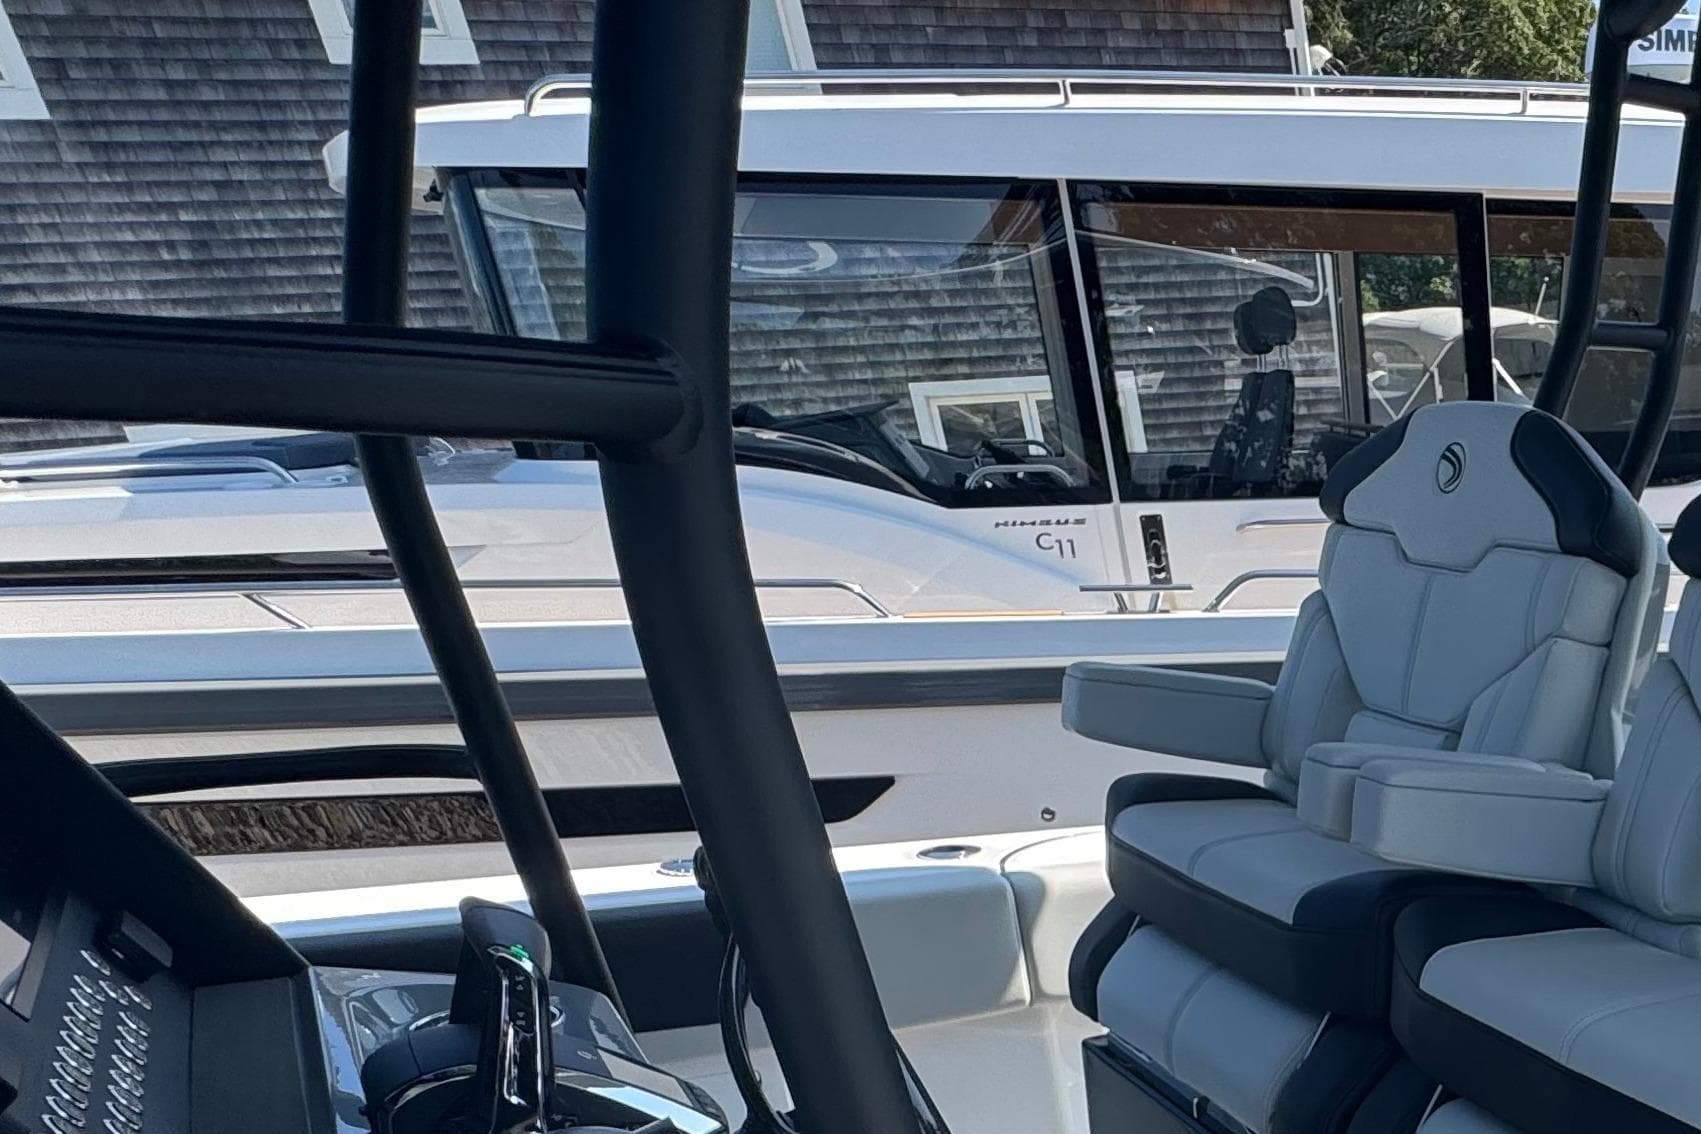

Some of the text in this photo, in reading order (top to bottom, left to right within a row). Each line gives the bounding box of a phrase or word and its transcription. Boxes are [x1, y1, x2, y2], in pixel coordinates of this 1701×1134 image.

[1637, 29, 1698, 52] SIM
[994, 518, 1087, 528] NIMBUS
[1035, 532, 1077, 559] C11
